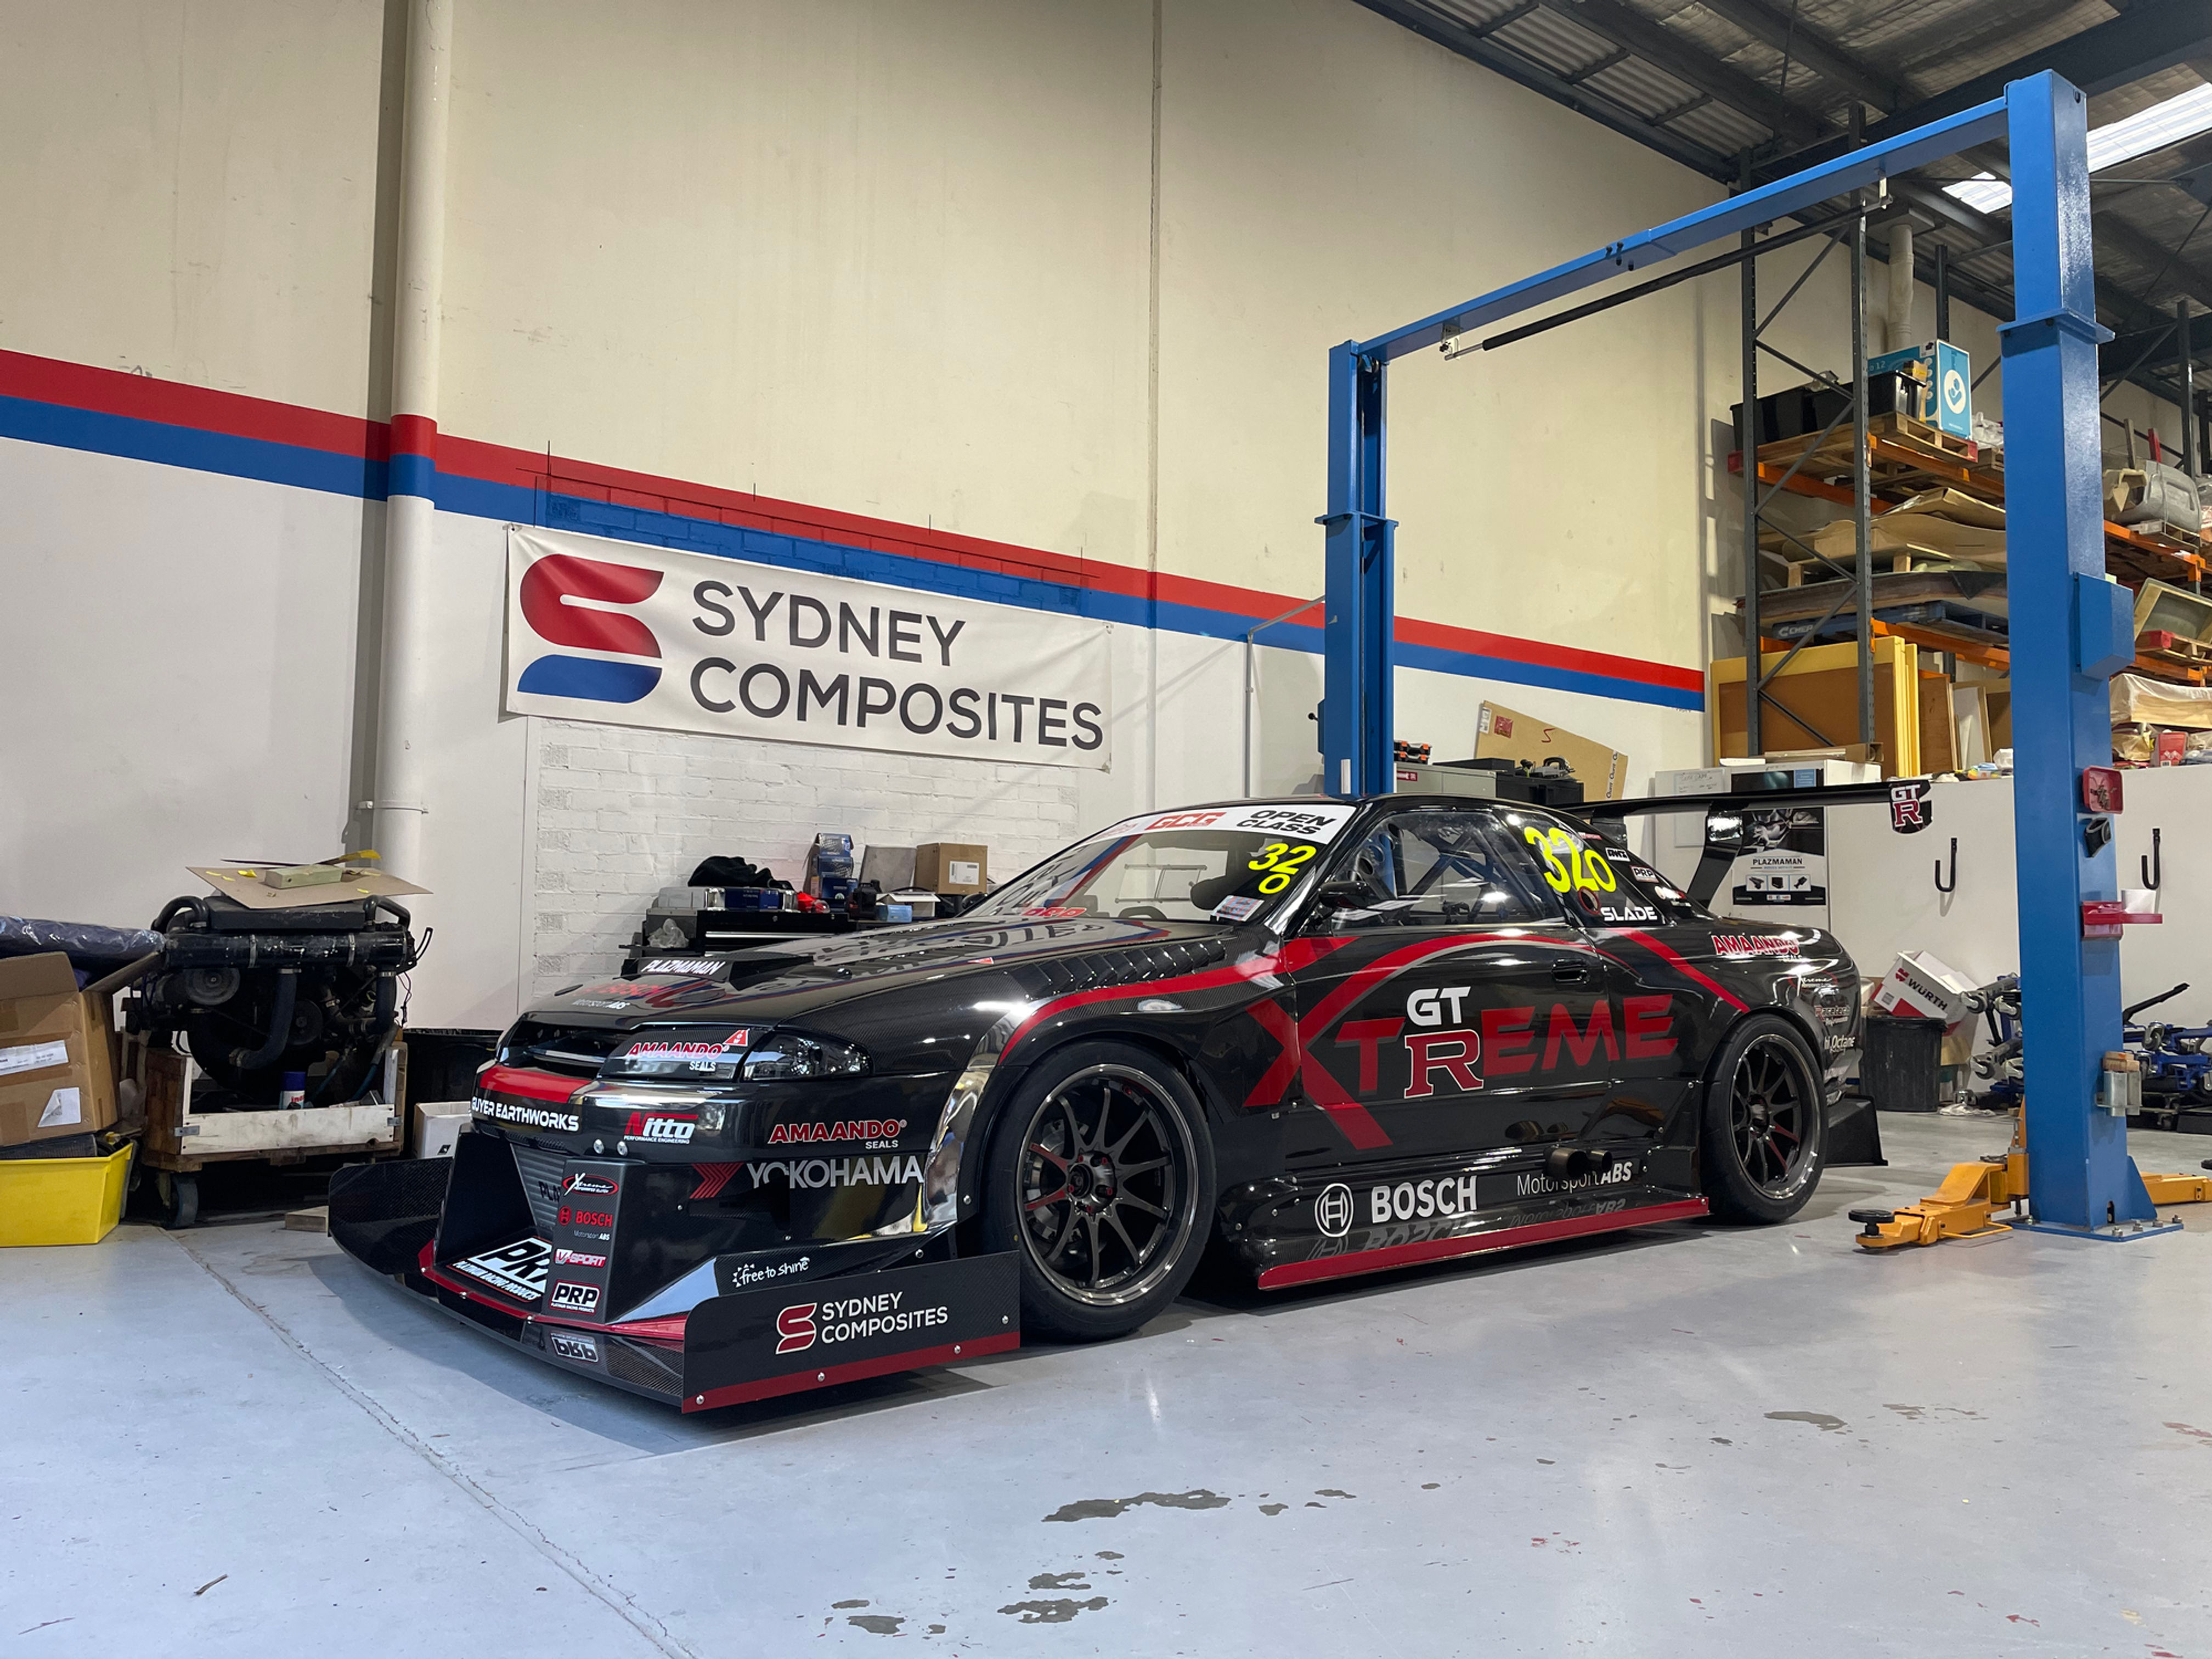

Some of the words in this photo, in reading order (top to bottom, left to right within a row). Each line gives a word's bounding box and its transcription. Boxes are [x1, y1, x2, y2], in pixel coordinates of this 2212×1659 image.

[691, 579, 966, 667] SYDNEY
[689, 656, 1104, 752] COMPOSITES
[1891, 784, 1921, 801] GT
[1144, 811, 1227, 831] GCG
[1250, 809, 1337, 827] OPEN
[1892, 799, 1923, 827] R
[1236, 819, 1321, 835] CLASS
[1248, 843, 1317, 875] 32
[1523, 826, 1617, 893] 320
[1633, 868, 1654, 877] PRP
[1600, 906, 1658, 922] SLADE
[1711, 934, 1800, 956] AMAANDO
[1407, 986, 1471, 1026] GT
[625, 1042, 723, 1060] AMAANDO
[689, 1061, 716, 1071] SEALS
[495, 1103, 579, 1132] EARTHWORKS
[624, 1111, 698, 1139] Nitto
[767, 1119, 901, 1145] AMAANDO
[865, 1139, 899, 1150] SEALS
[746, 1155, 925, 1189] YOKOHAMA
[1372, 1176, 1478, 1224] BOSCH
[575, 1210, 613, 1228] BOSCH
[475, 1240, 551, 1284] PR
[738, 1266, 765, 1285] free
[765, 1266, 777, 1279] to
[777, 1259, 810, 1277] shine
[554, 1284, 598, 1305] PRP
[821, 1291, 903, 1321] SYDNEY
[821, 1306, 949, 1344] COMPOSITES
